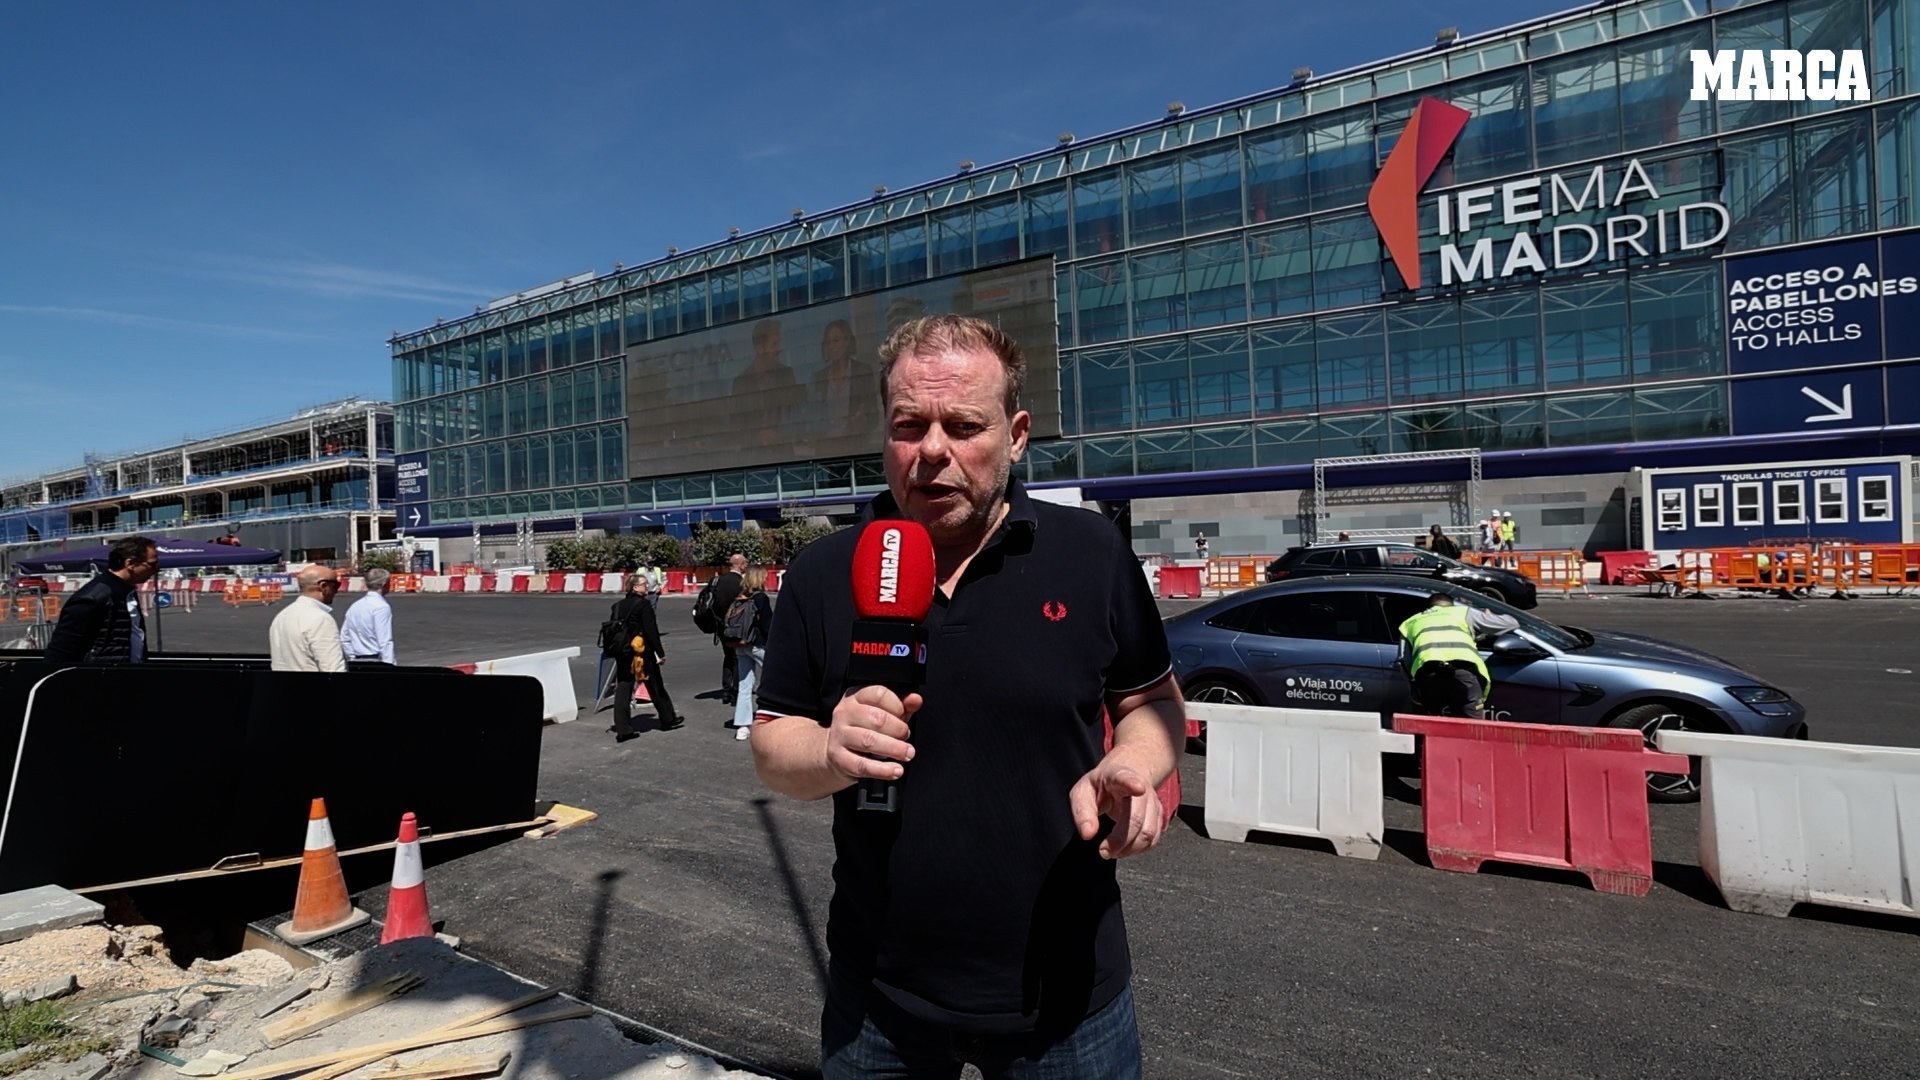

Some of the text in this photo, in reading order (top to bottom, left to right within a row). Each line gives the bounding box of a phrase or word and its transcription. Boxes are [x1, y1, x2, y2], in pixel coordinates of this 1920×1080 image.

[1438, 158, 1660, 236] IFEMA
[1440, 202, 1731, 286] MADRID
[1729, 262, 1873, 296] ACCESO A
[1730, 276, 1919, 314] PABELLONES
[1731, 306, 1835, 334] ACCESS
[1732, 323, 1862, 352] TO HALLS
[1720, 468, 1847, 482] TAQUILLAS TICKET OFFICE
[879, 549, 899, 603] MARCA
[852, 641, 891, 655] MARCA
[1286, 688, 1337, 701] eléctrico
[1299, 677, 1364, 692] Viaja 100%
